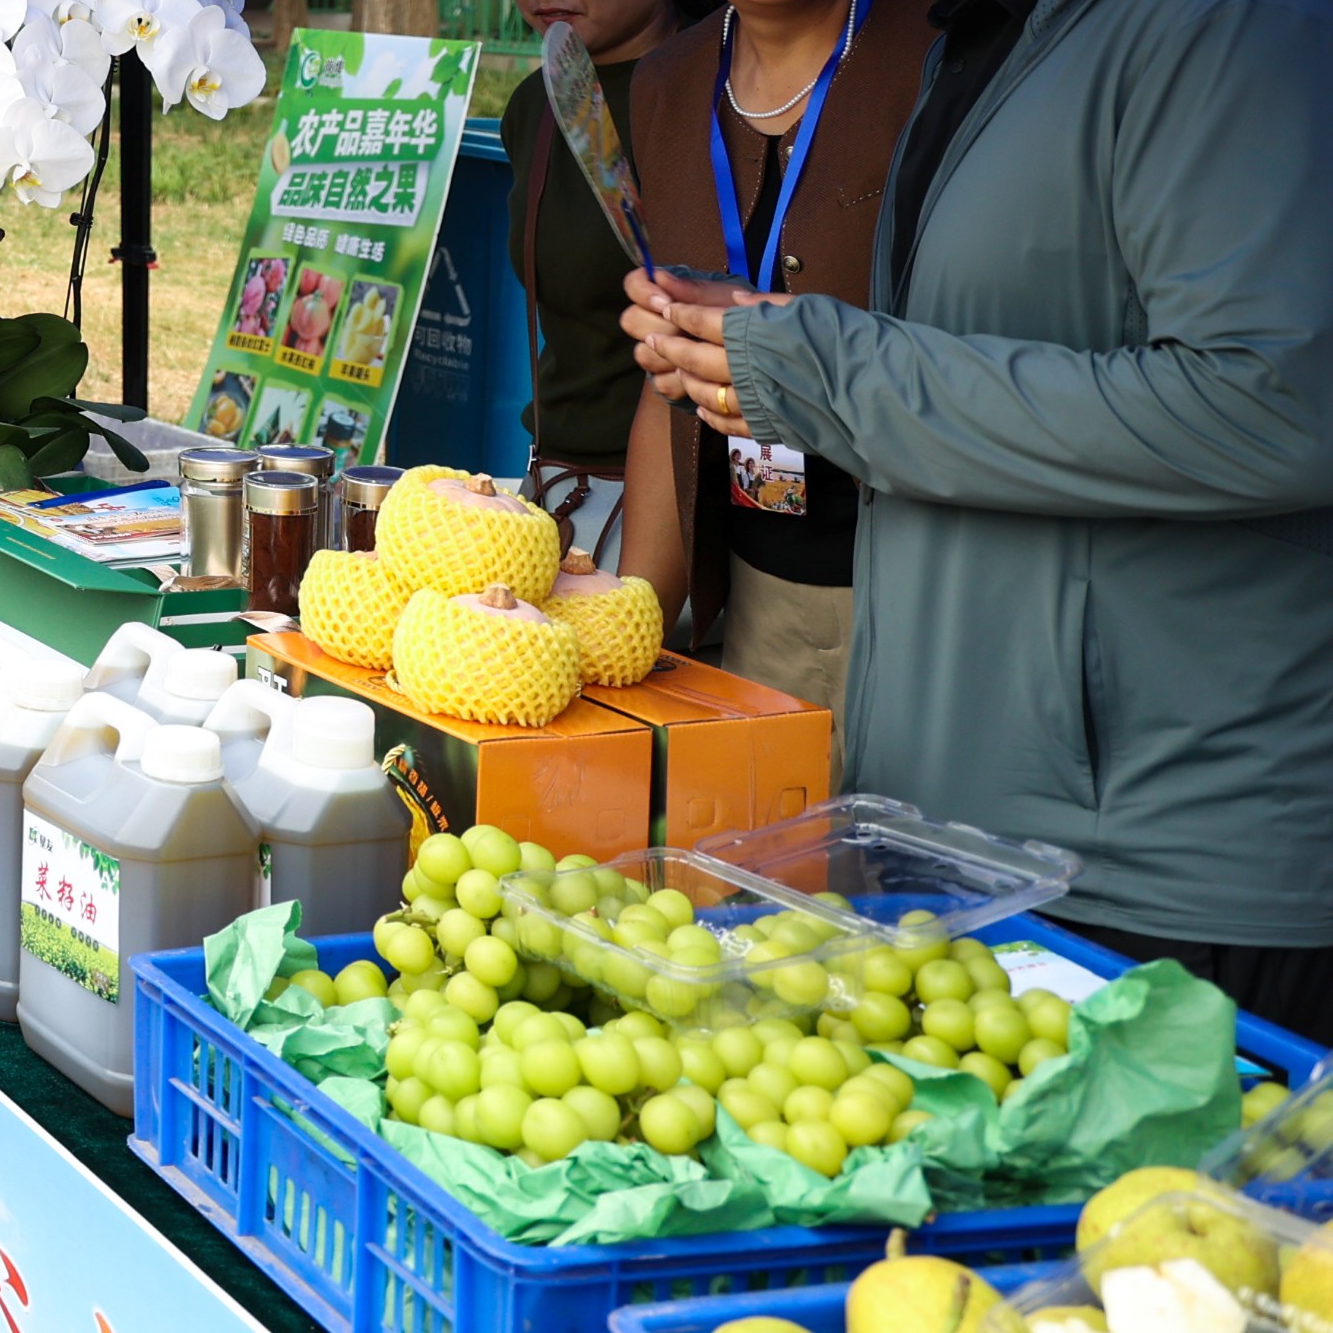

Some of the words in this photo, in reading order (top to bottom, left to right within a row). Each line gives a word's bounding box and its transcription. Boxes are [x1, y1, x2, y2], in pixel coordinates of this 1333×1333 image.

[290, 106, 437, 160] 农产品嘉年华
[277, 163, 418, 214] 品味自然之果
[281, 222, 330, 250] 绿色品质
[335, 233, 386, 263] 健康生活
[414, 325, 473, 356] 可回收物
[35, 860, 98, 926] 菜籽油
